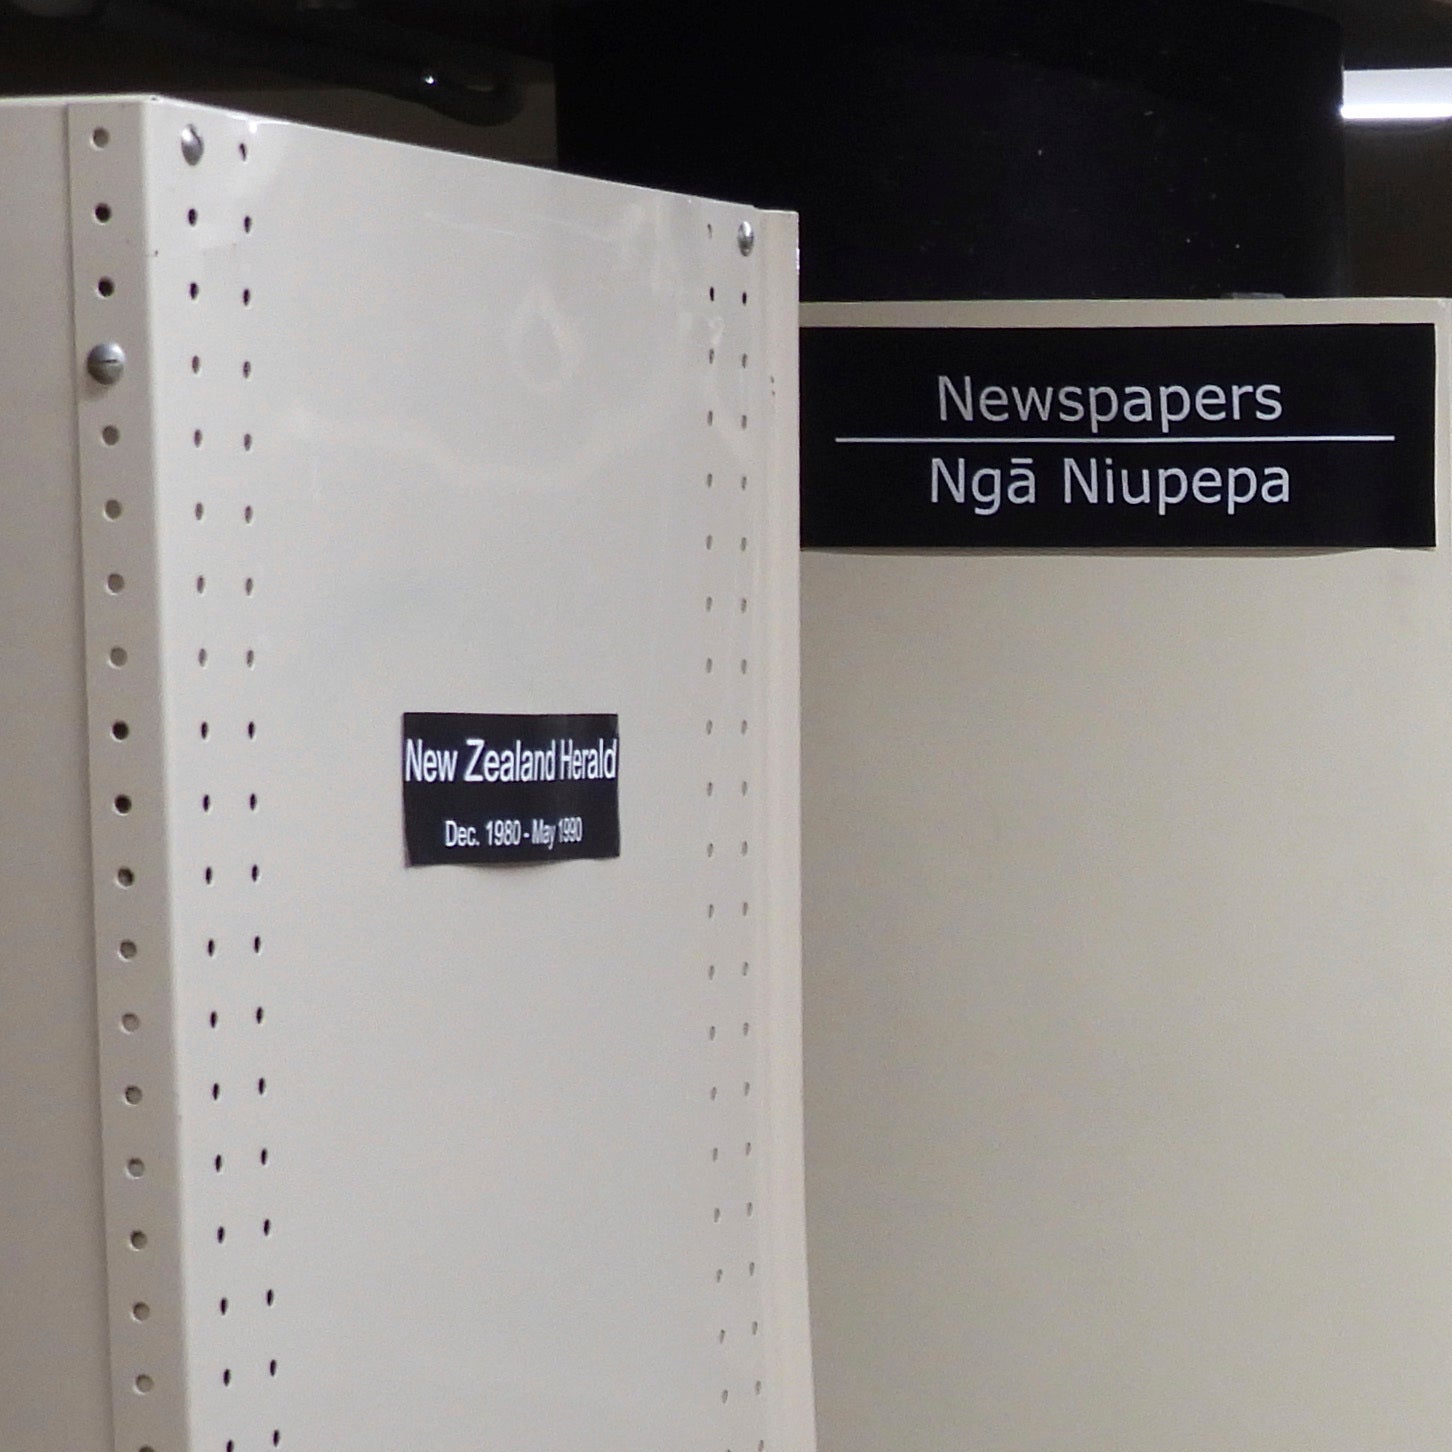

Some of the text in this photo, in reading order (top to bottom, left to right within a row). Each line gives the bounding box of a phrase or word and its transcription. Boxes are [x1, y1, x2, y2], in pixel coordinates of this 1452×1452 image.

[938, 375, 1283, 433] Newspapers
[931, 457, 1290, 516] Ngā Niupepa
[404, 738, 618, 782] New Zealand Herald
[445, 820, 480, 847] Dec.
[485, 819, 521, 846] 1980
[531, 818, 556, 850] May
[557, 816, 583, 843] 1990
